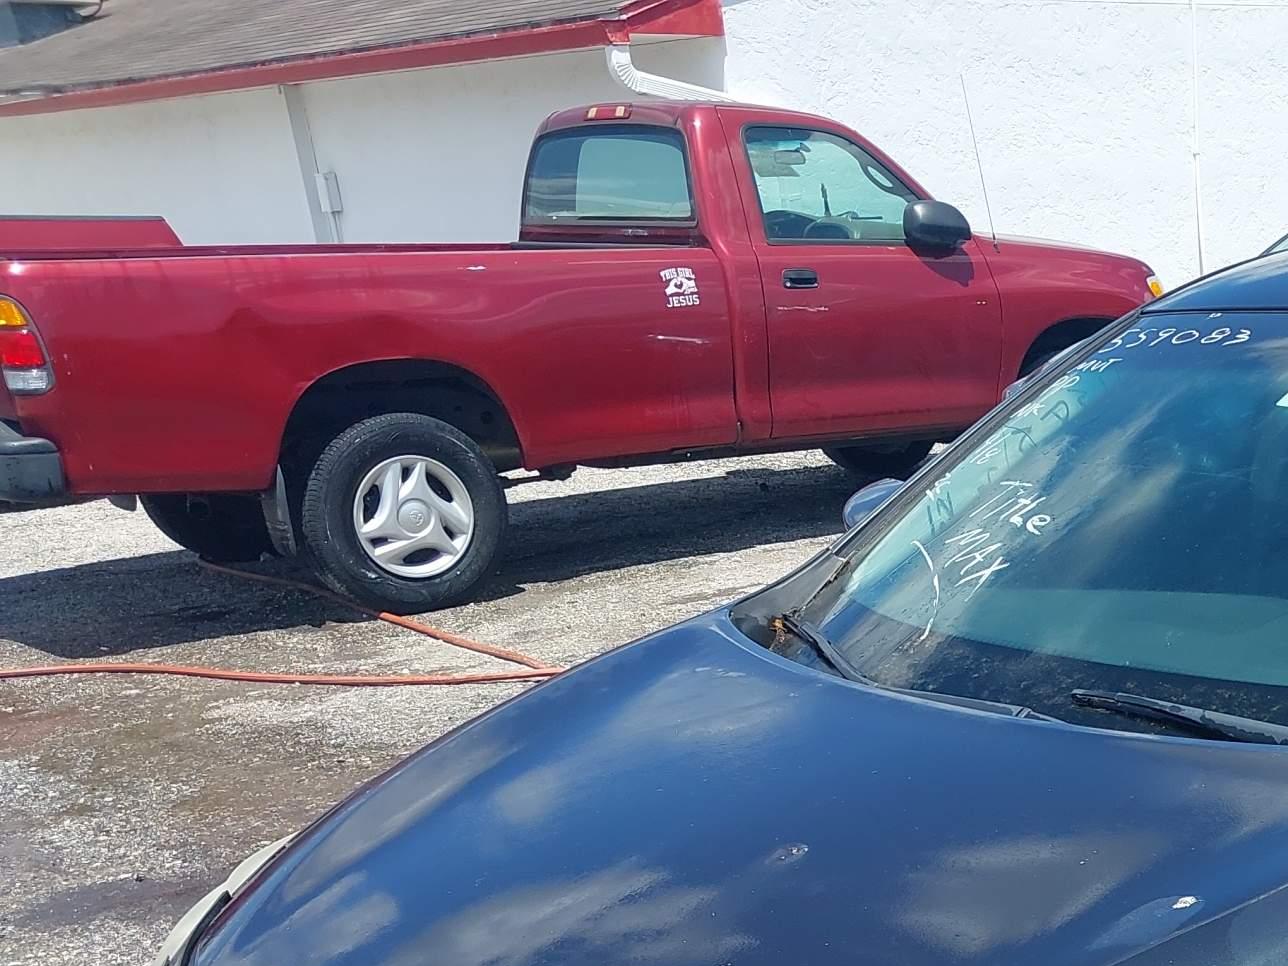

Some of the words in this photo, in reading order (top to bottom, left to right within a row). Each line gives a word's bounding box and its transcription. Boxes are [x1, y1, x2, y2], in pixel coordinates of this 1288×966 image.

[667, 294, 700, 308] JESUS
[1098, 326, 1252, 354] 559083
[943, 528, 1011, 602] MAX
